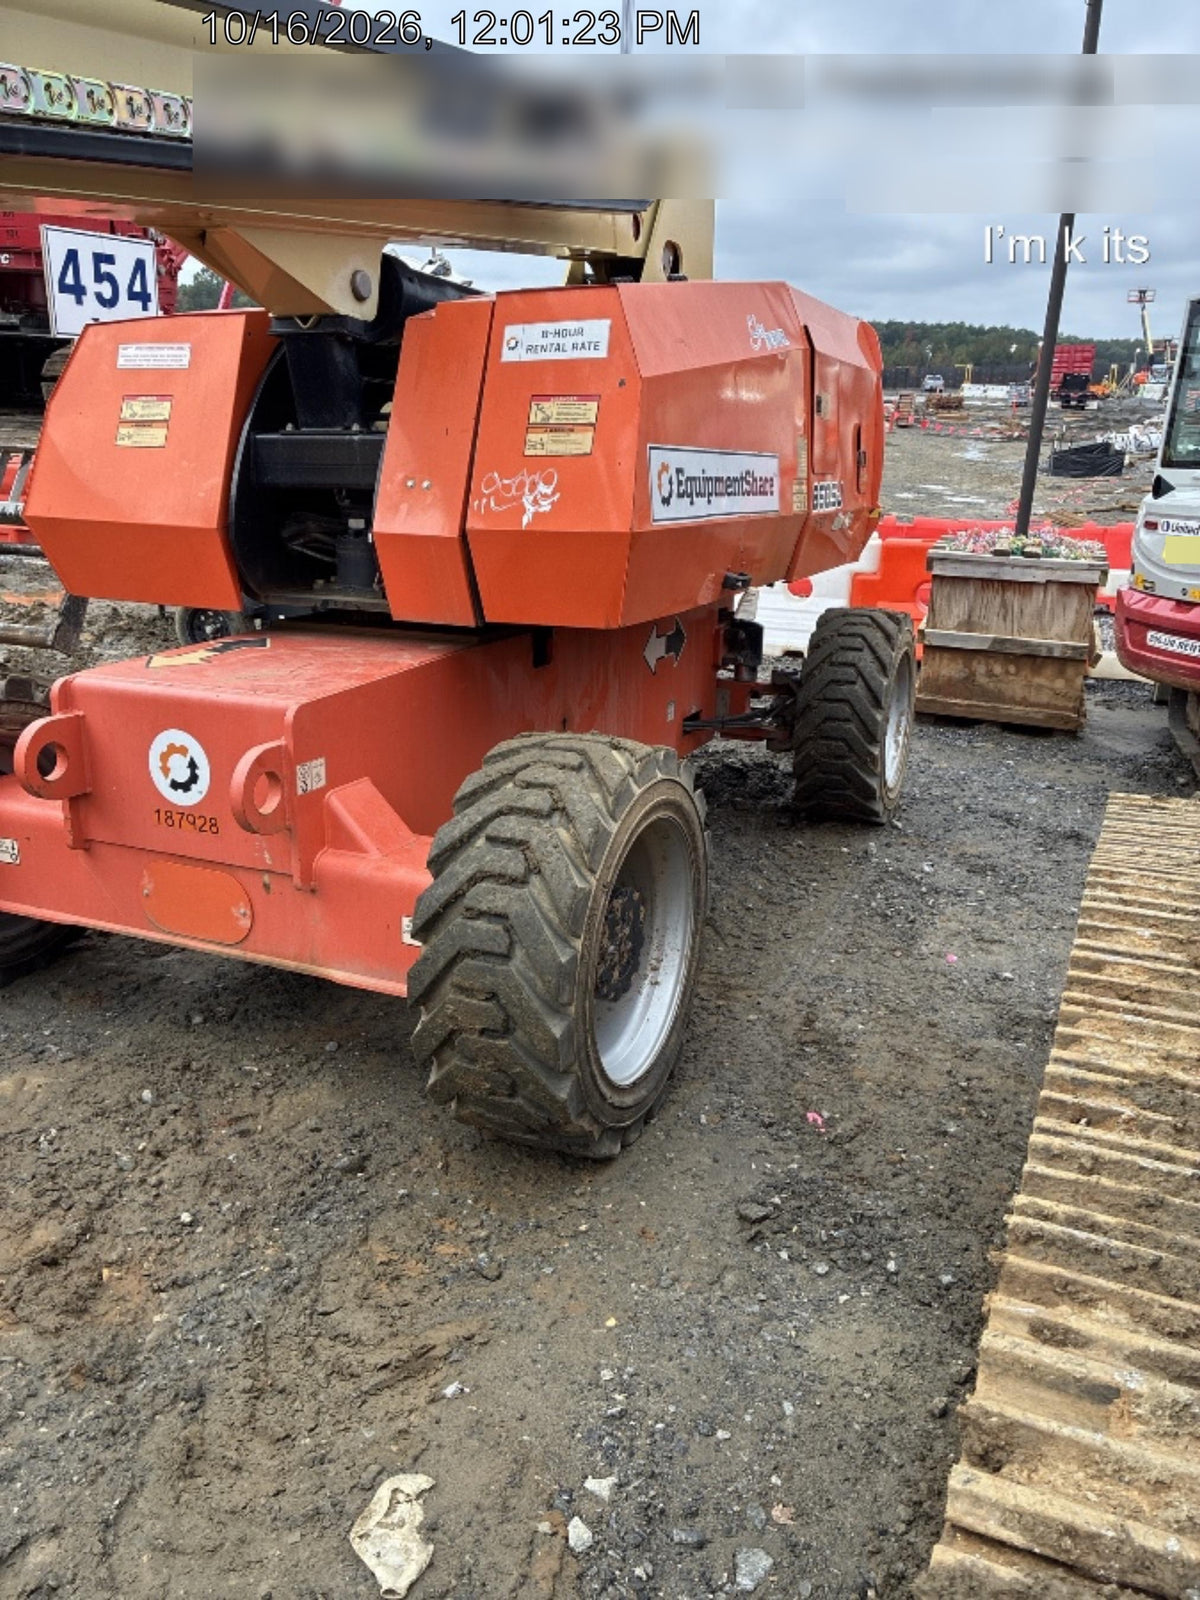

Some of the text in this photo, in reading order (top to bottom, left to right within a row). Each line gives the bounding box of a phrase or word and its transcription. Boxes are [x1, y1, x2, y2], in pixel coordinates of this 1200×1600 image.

[57, 248, 152, 312] 454
[526, 340, 601, 355] RENTAL RATE
[675, 466, 775, 506] EquipmentShare
[154, 808, 220, 835] 187928
